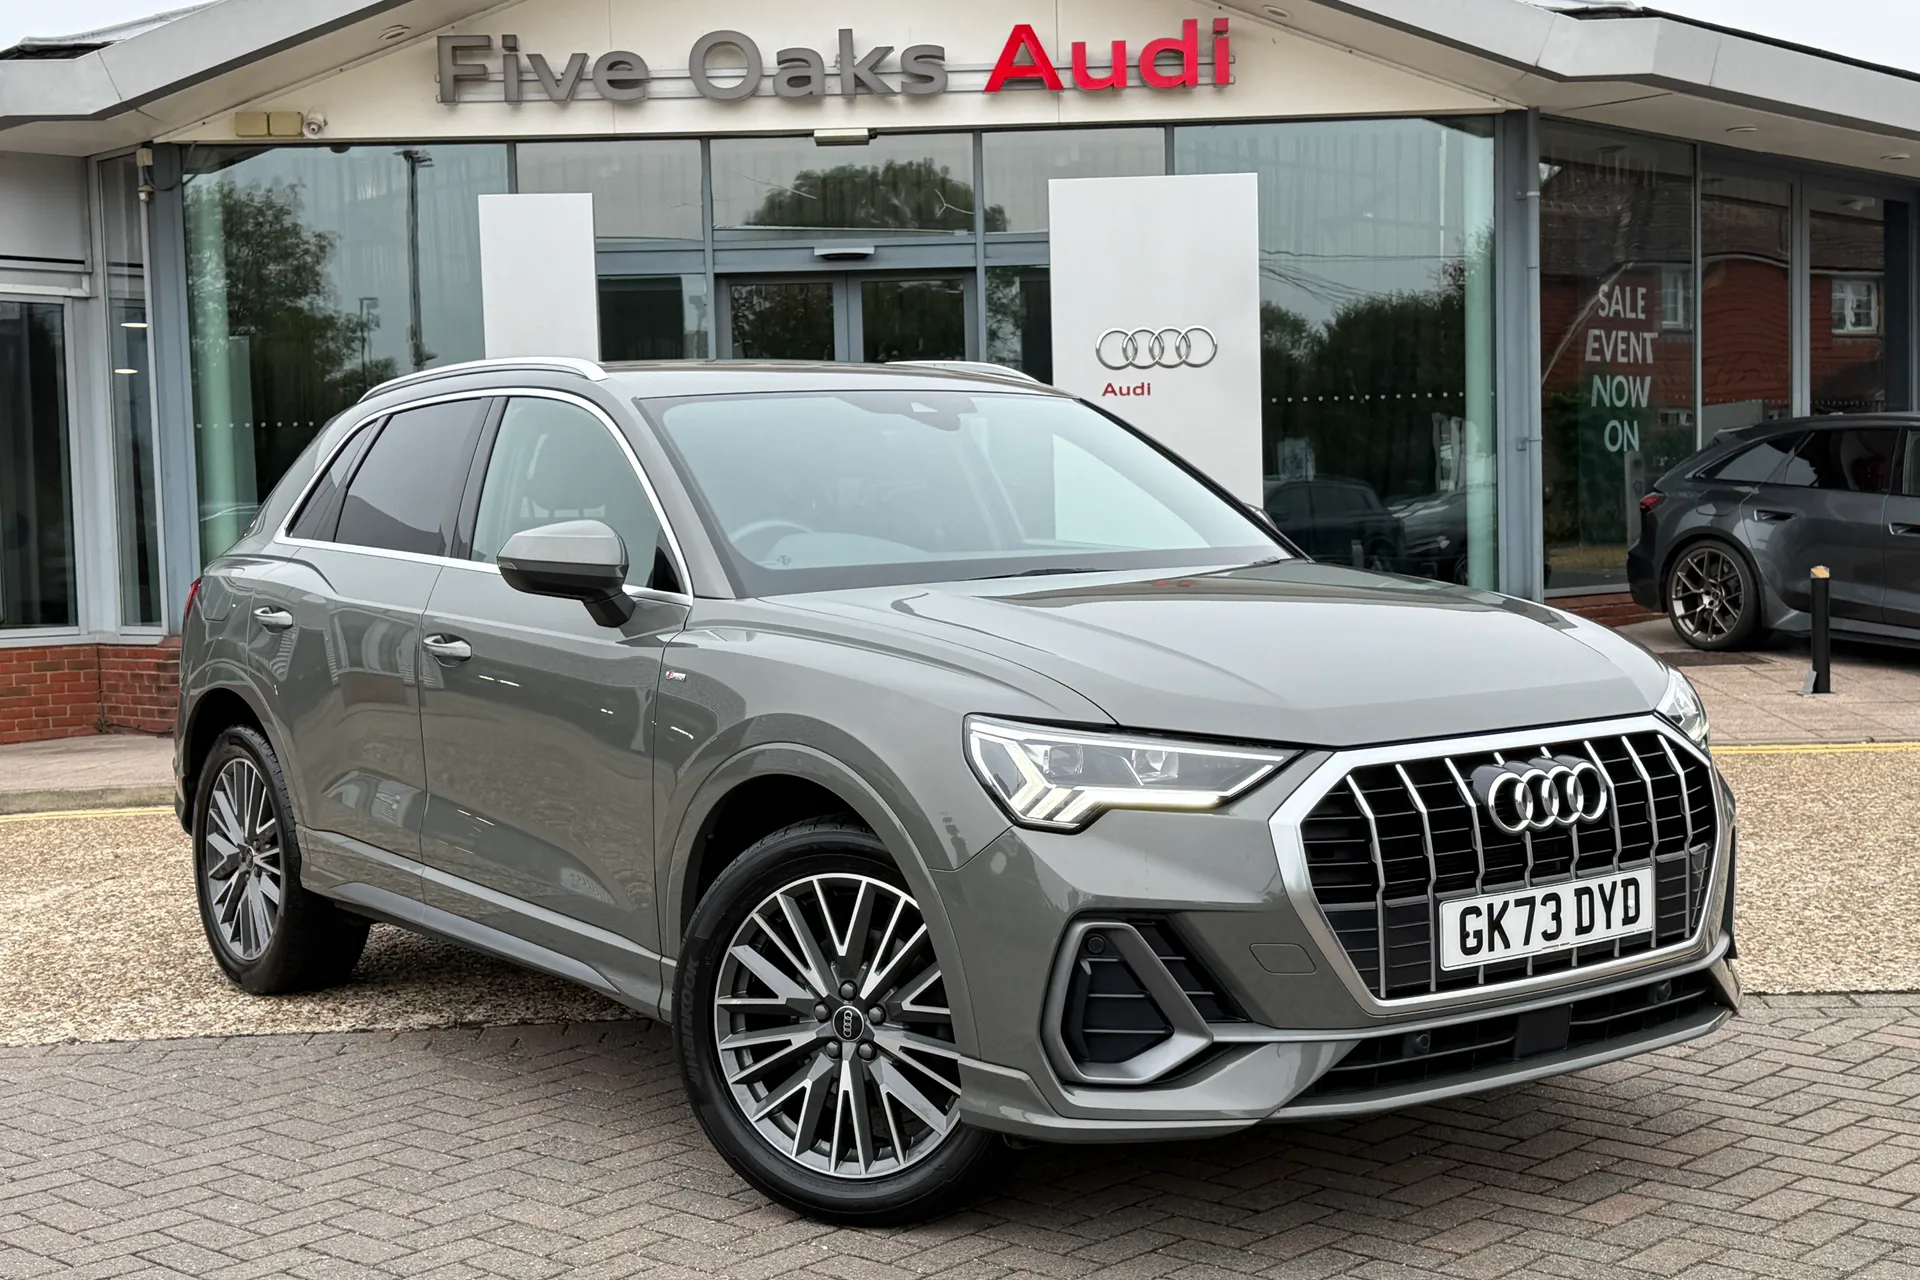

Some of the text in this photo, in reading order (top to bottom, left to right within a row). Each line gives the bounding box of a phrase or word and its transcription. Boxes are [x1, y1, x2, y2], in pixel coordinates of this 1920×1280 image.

[437, 17, 1230, 105] Five Oaks Audi
[1598, 284, 1647, 320] SALE
[1585, 328, 1659, 365] EVENT
[1101, 382, 1151, 397] Audi
[1591, 374, 1652, 408] NOW
[1603, 419, 1640, 453] ON
[1459, 877, 1641, 957] GK73 DYD
